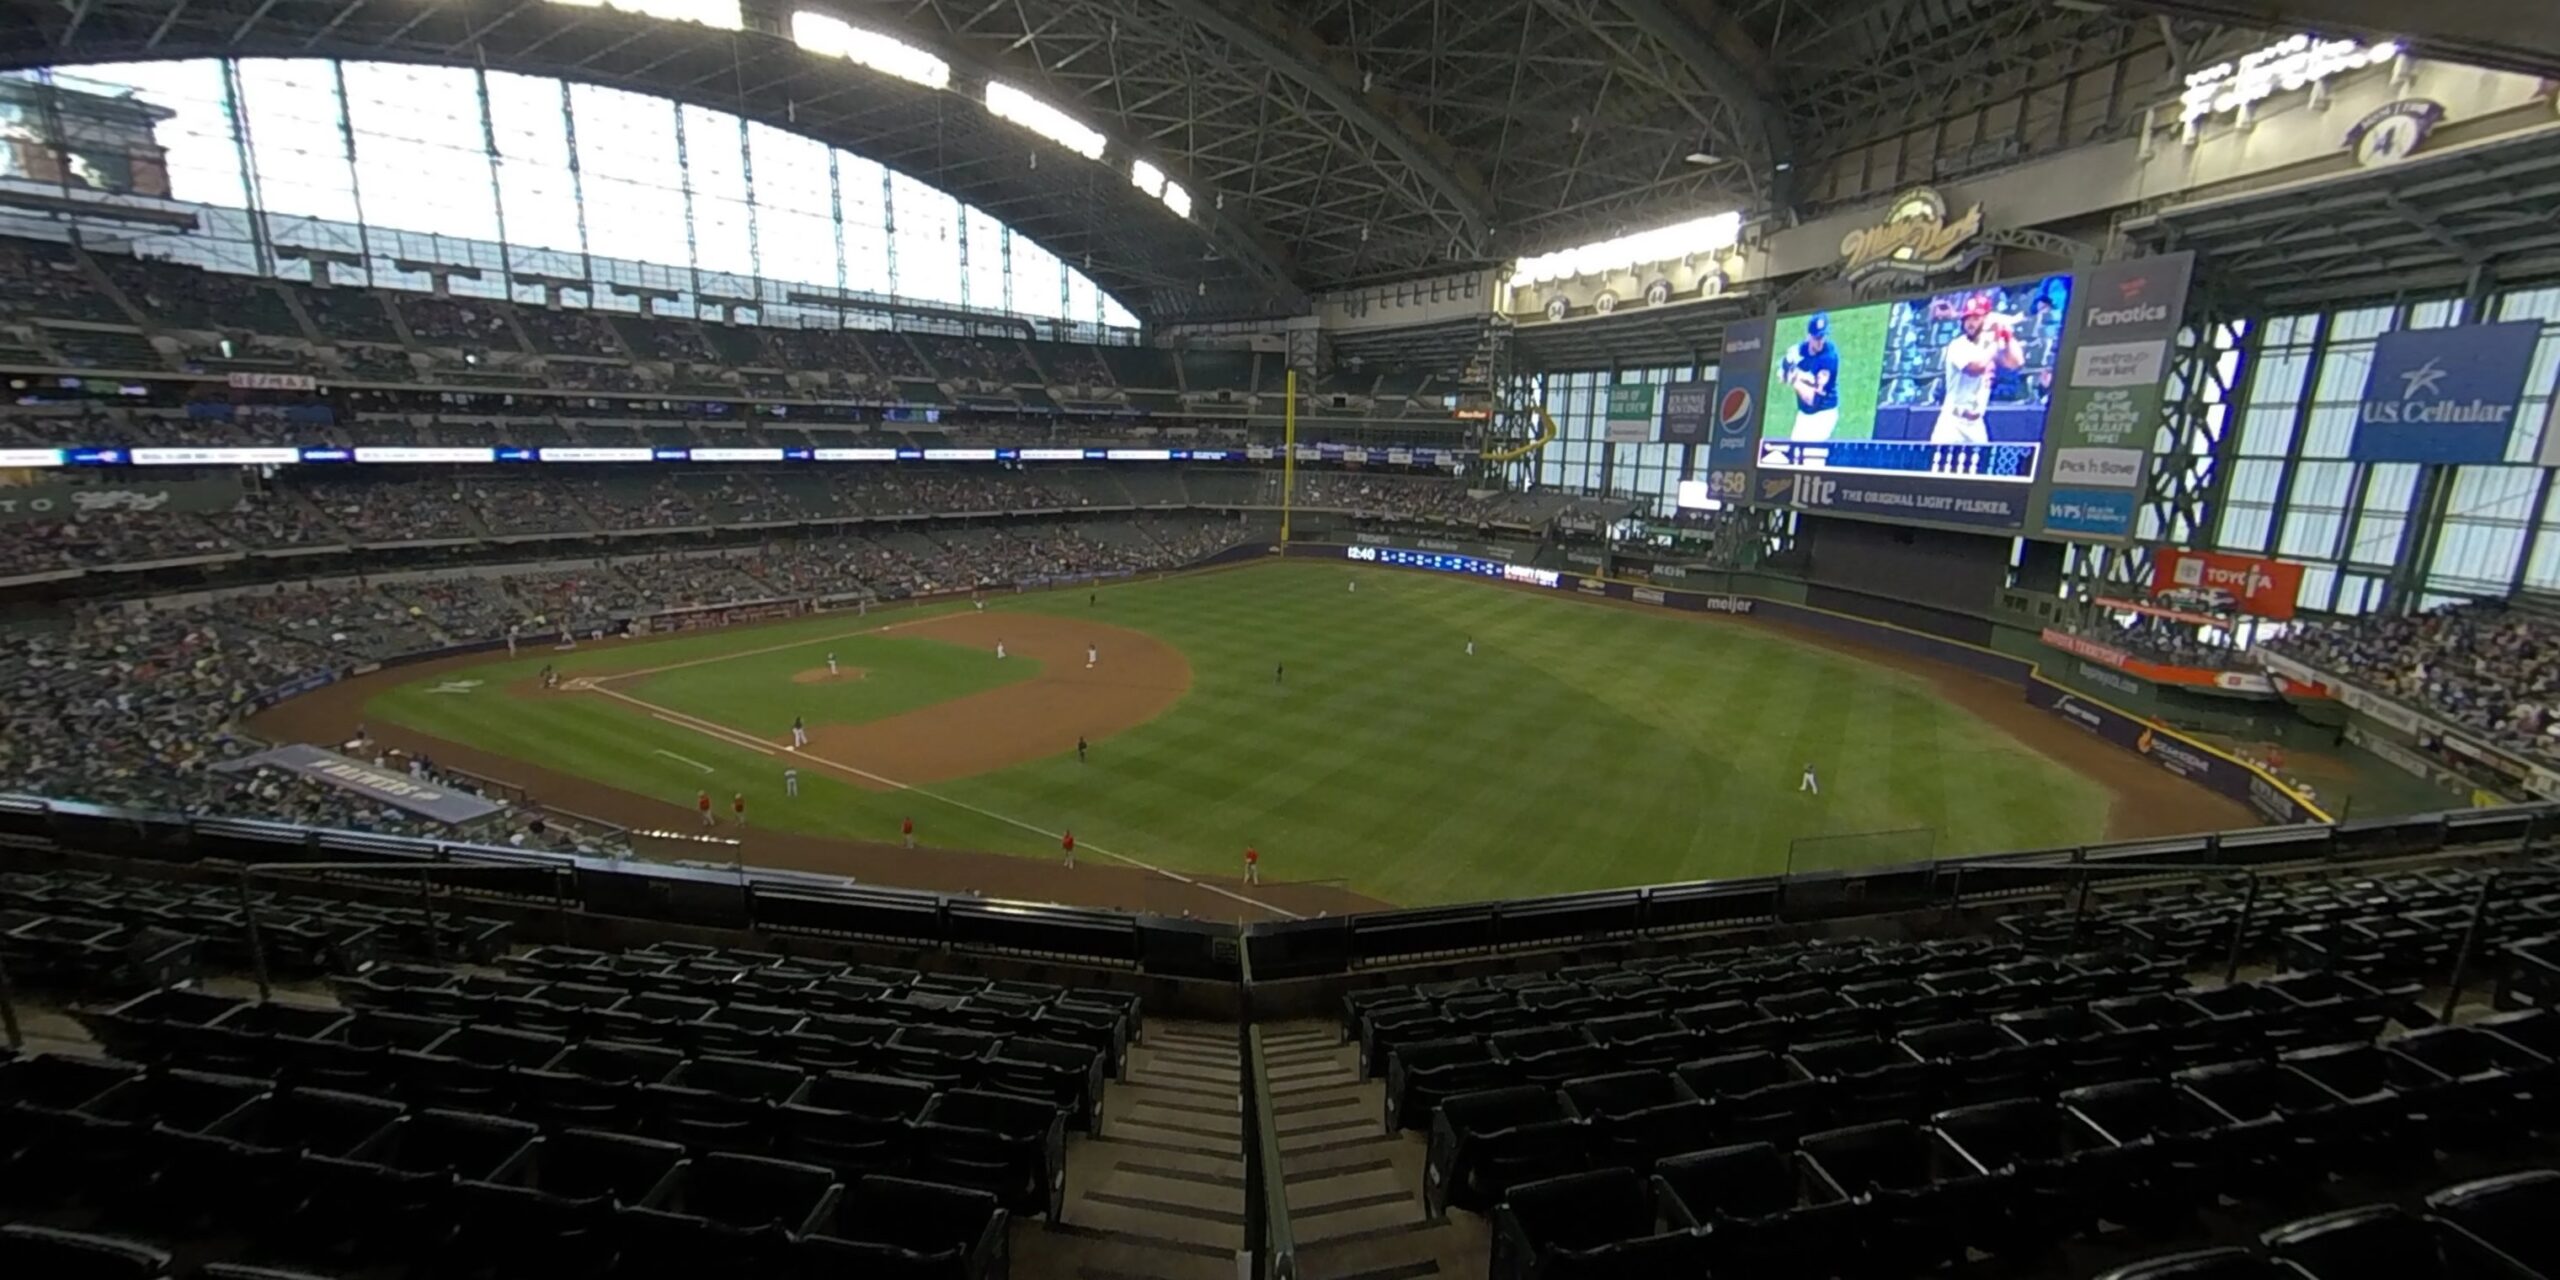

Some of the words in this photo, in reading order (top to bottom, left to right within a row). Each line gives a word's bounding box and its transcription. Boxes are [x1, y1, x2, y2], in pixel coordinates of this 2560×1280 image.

[2086, 303, 2167, 328] Fanatics
[2087, 363, 2138, 377] market
[2403, 398, 2512, 424] Cellular
[2059, 459, 2085, 473] Pick
[2099, 460, 2136, 475] Save
[1722, 472, 1746, 493] 58
[1790, 474, 1837, 509] Lite
[1841, 488, 1863, 502] THE
[1863, 491, 1914, 508] ORIGINAL
[1916, 496, 1953, 510] LIGHT
[2050, 503, 2081, 519] WPS
[1347, 546, 1376, 561] 12:40
[2207, 567, 2272, 590] TOYOA
[1707, 595, 1753, 614] meijer
